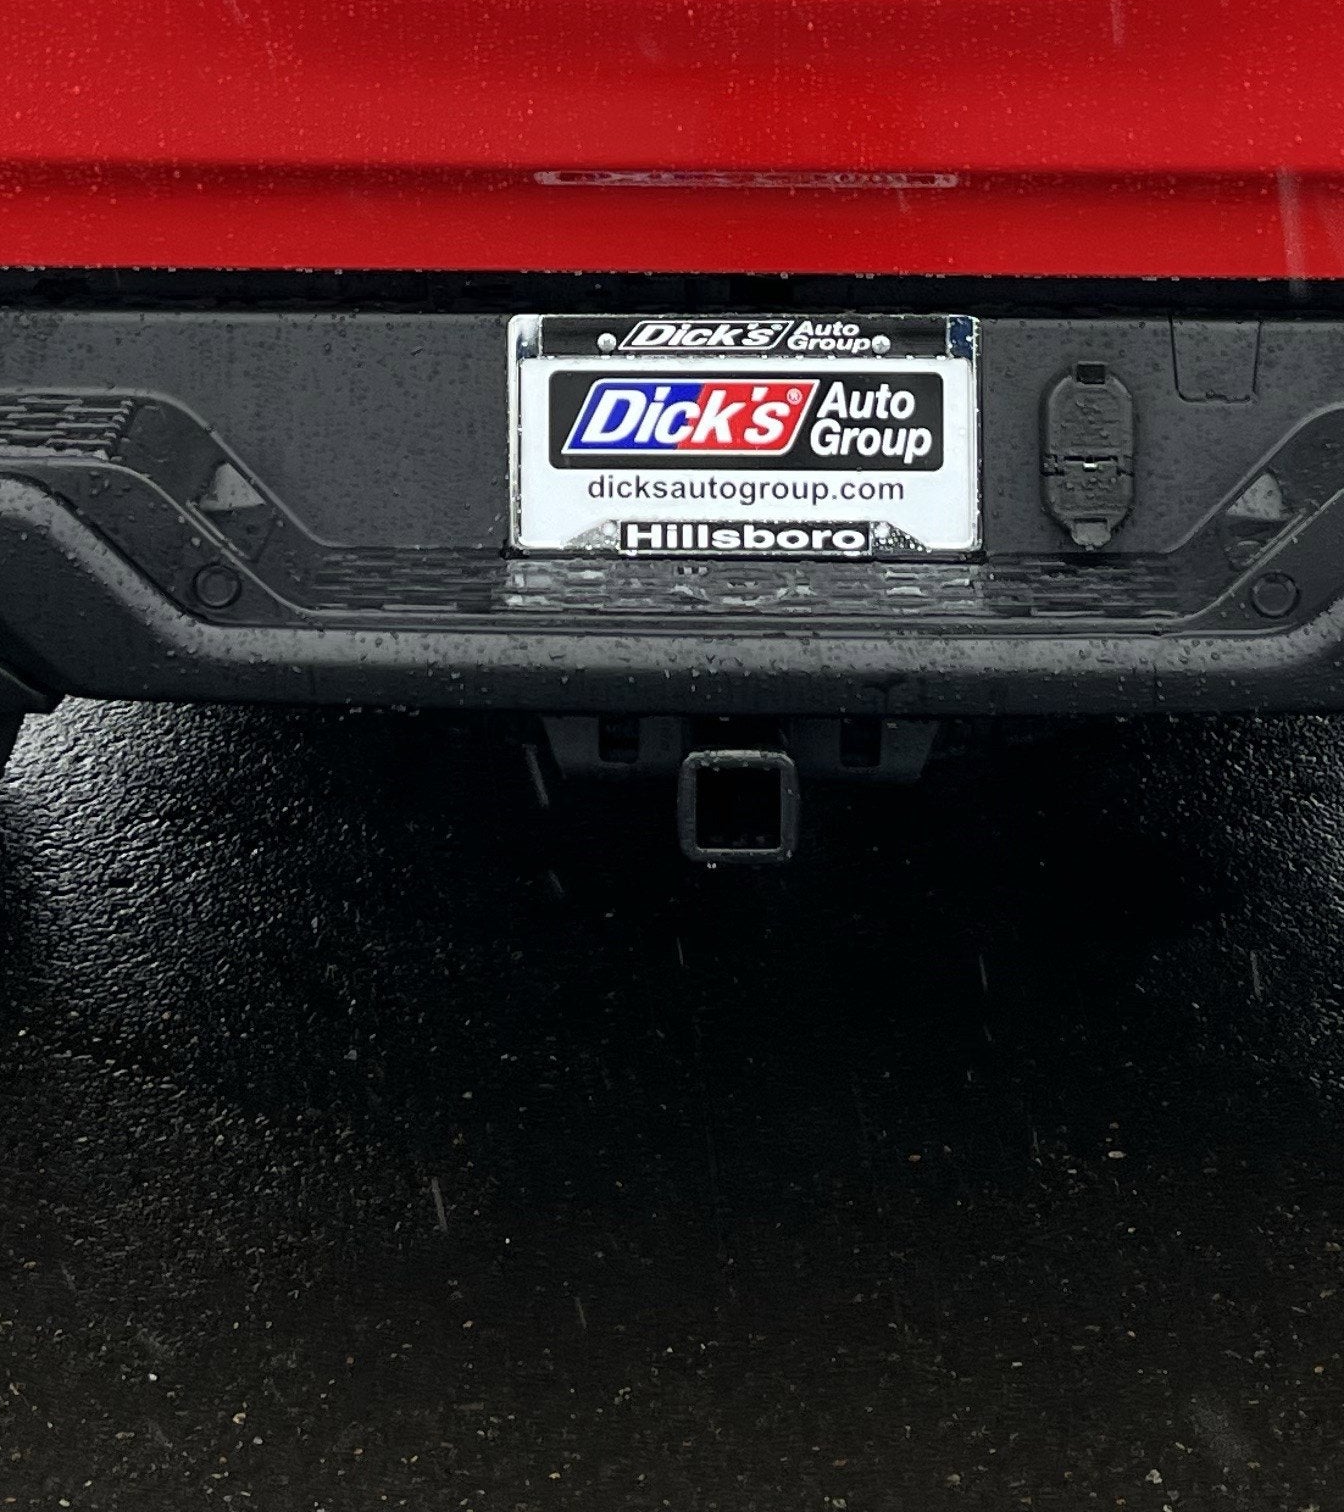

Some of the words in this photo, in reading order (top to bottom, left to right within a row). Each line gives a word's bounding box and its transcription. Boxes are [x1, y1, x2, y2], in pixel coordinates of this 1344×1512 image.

[630, 321, 771, 347] Dick's
[793, 320, 860, 337] Auto
[787, 336, 872, 354] Group
[580, 386, 791, 445] Dick's
[816, 381, 916, 420] Auto
[809, 421, 933, 464] Group
[587, 474, 905, 506] dicksautogroup.com
[625, 523, 866, 551] Hillsboro
